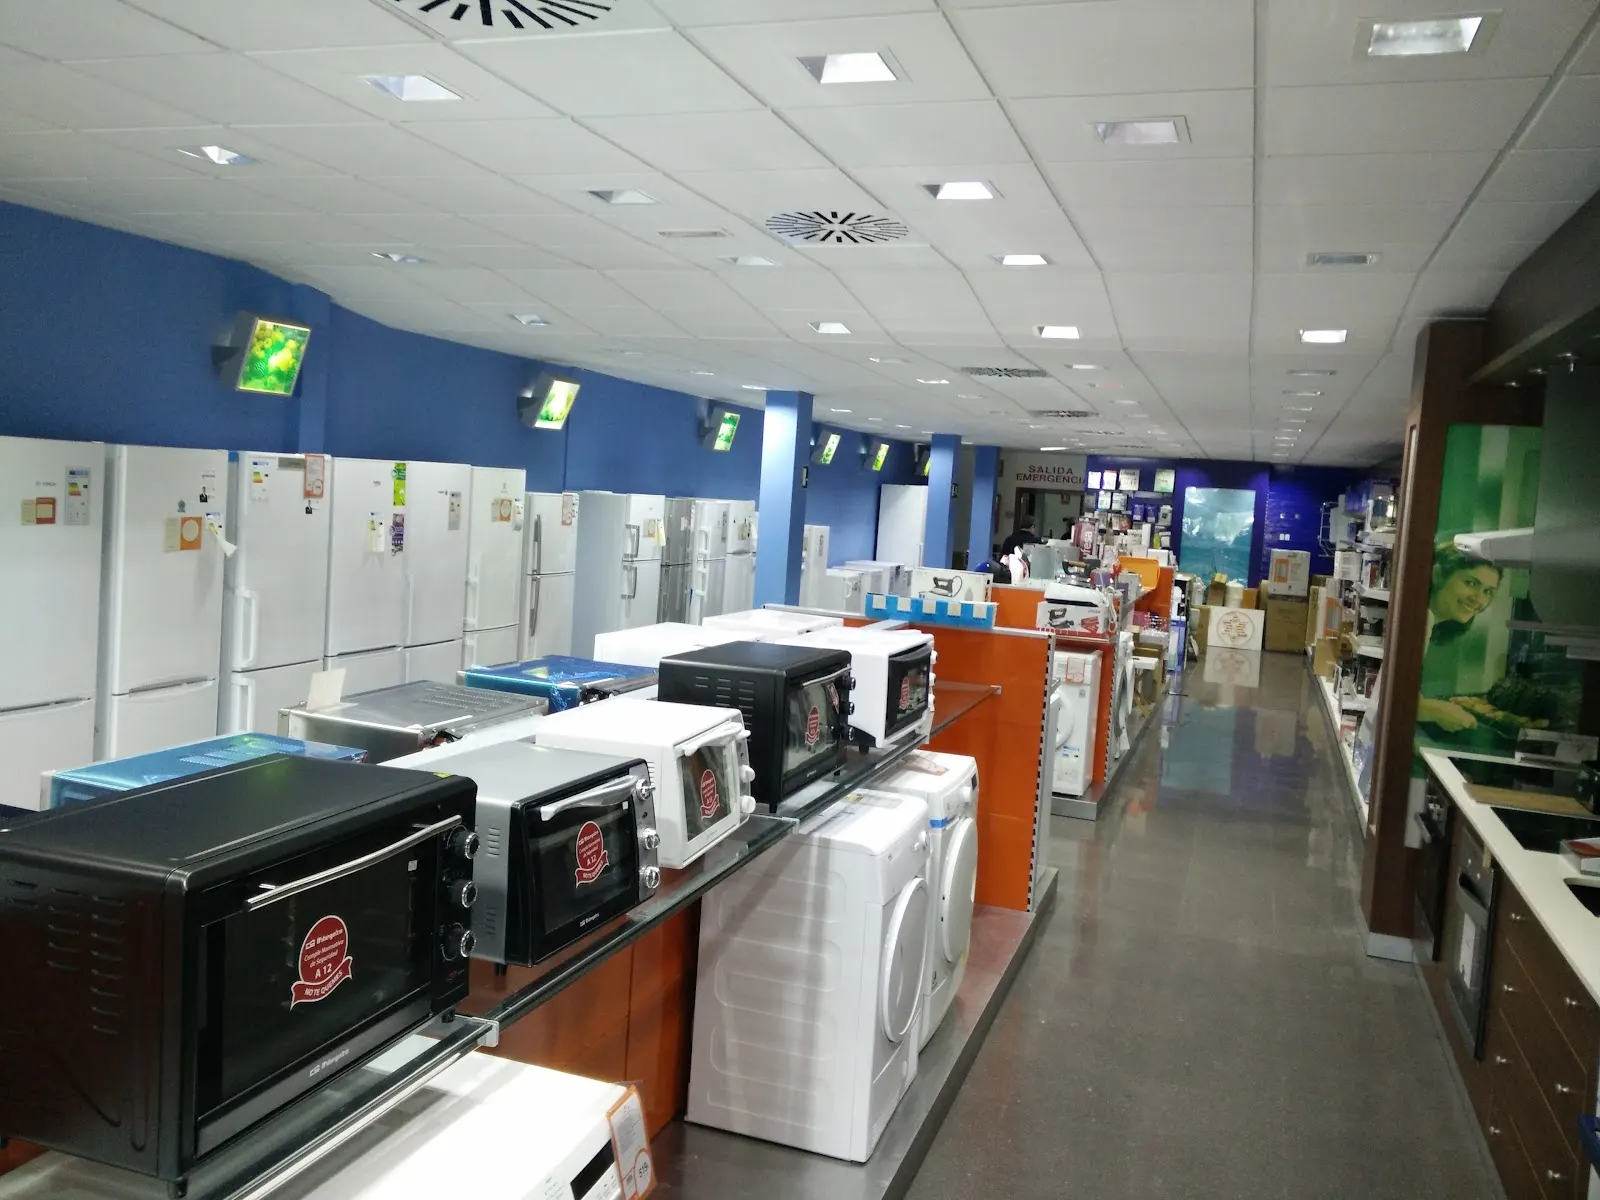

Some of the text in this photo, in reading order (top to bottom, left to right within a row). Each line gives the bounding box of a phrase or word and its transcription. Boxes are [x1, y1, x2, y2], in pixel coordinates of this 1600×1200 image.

[1028, 465, 1074, 475] SALIDA
[314, 963, 332, 979] A 12
[304, 970, 343, 996] NO TE QUEMES
